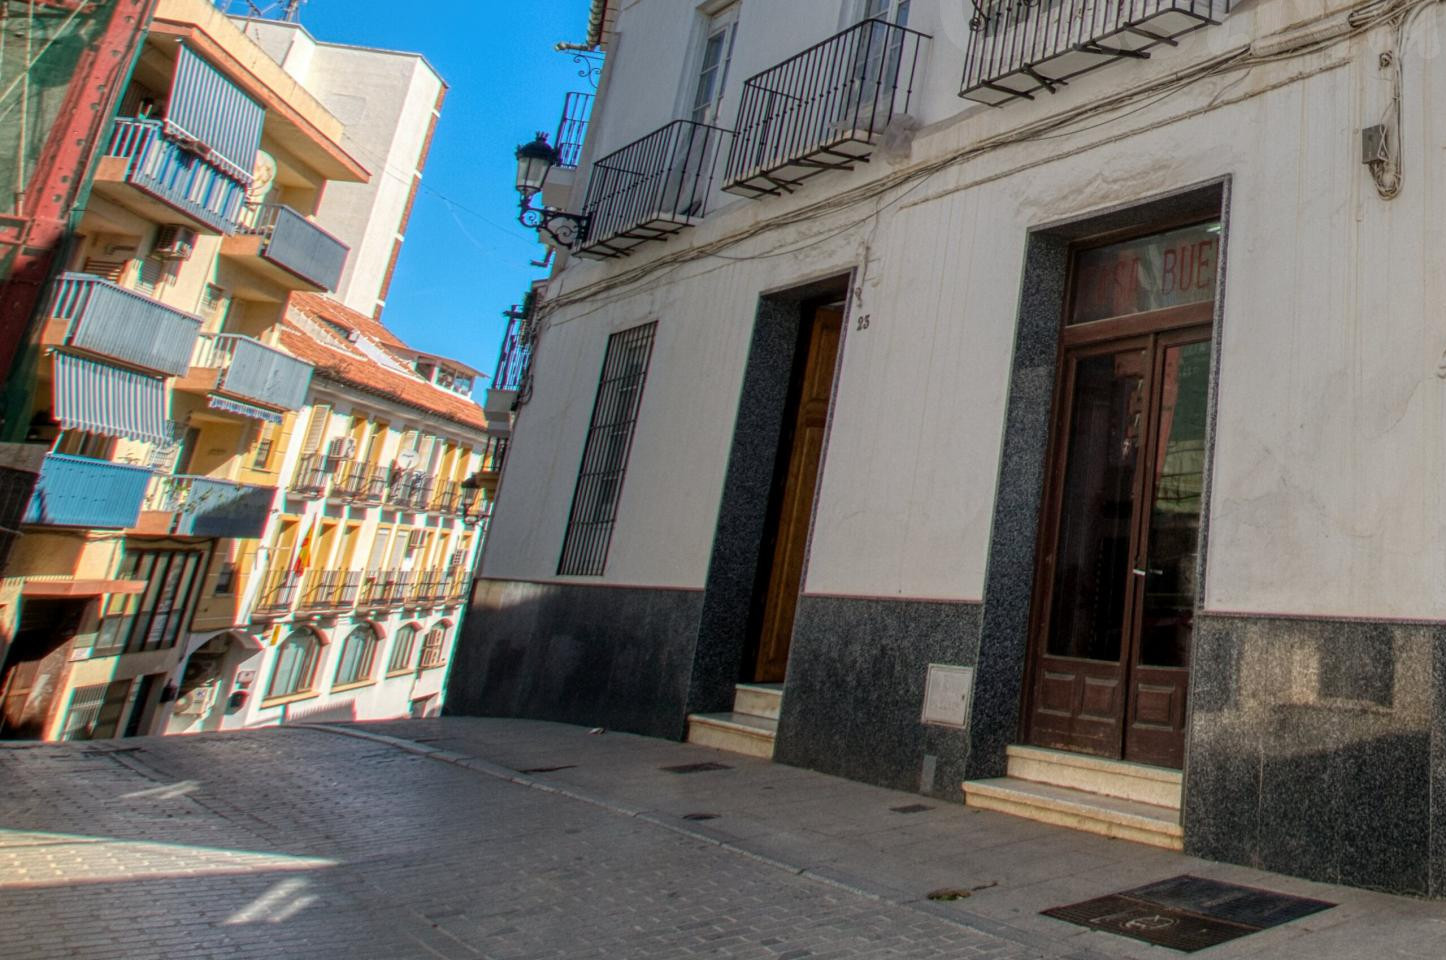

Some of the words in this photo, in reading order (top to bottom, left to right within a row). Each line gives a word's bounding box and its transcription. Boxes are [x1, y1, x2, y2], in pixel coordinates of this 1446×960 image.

[1084, 257, 1141, 306] ASA
[1161, 237, 1220, 296] BUE
[856, 314, 870, 331] 25
